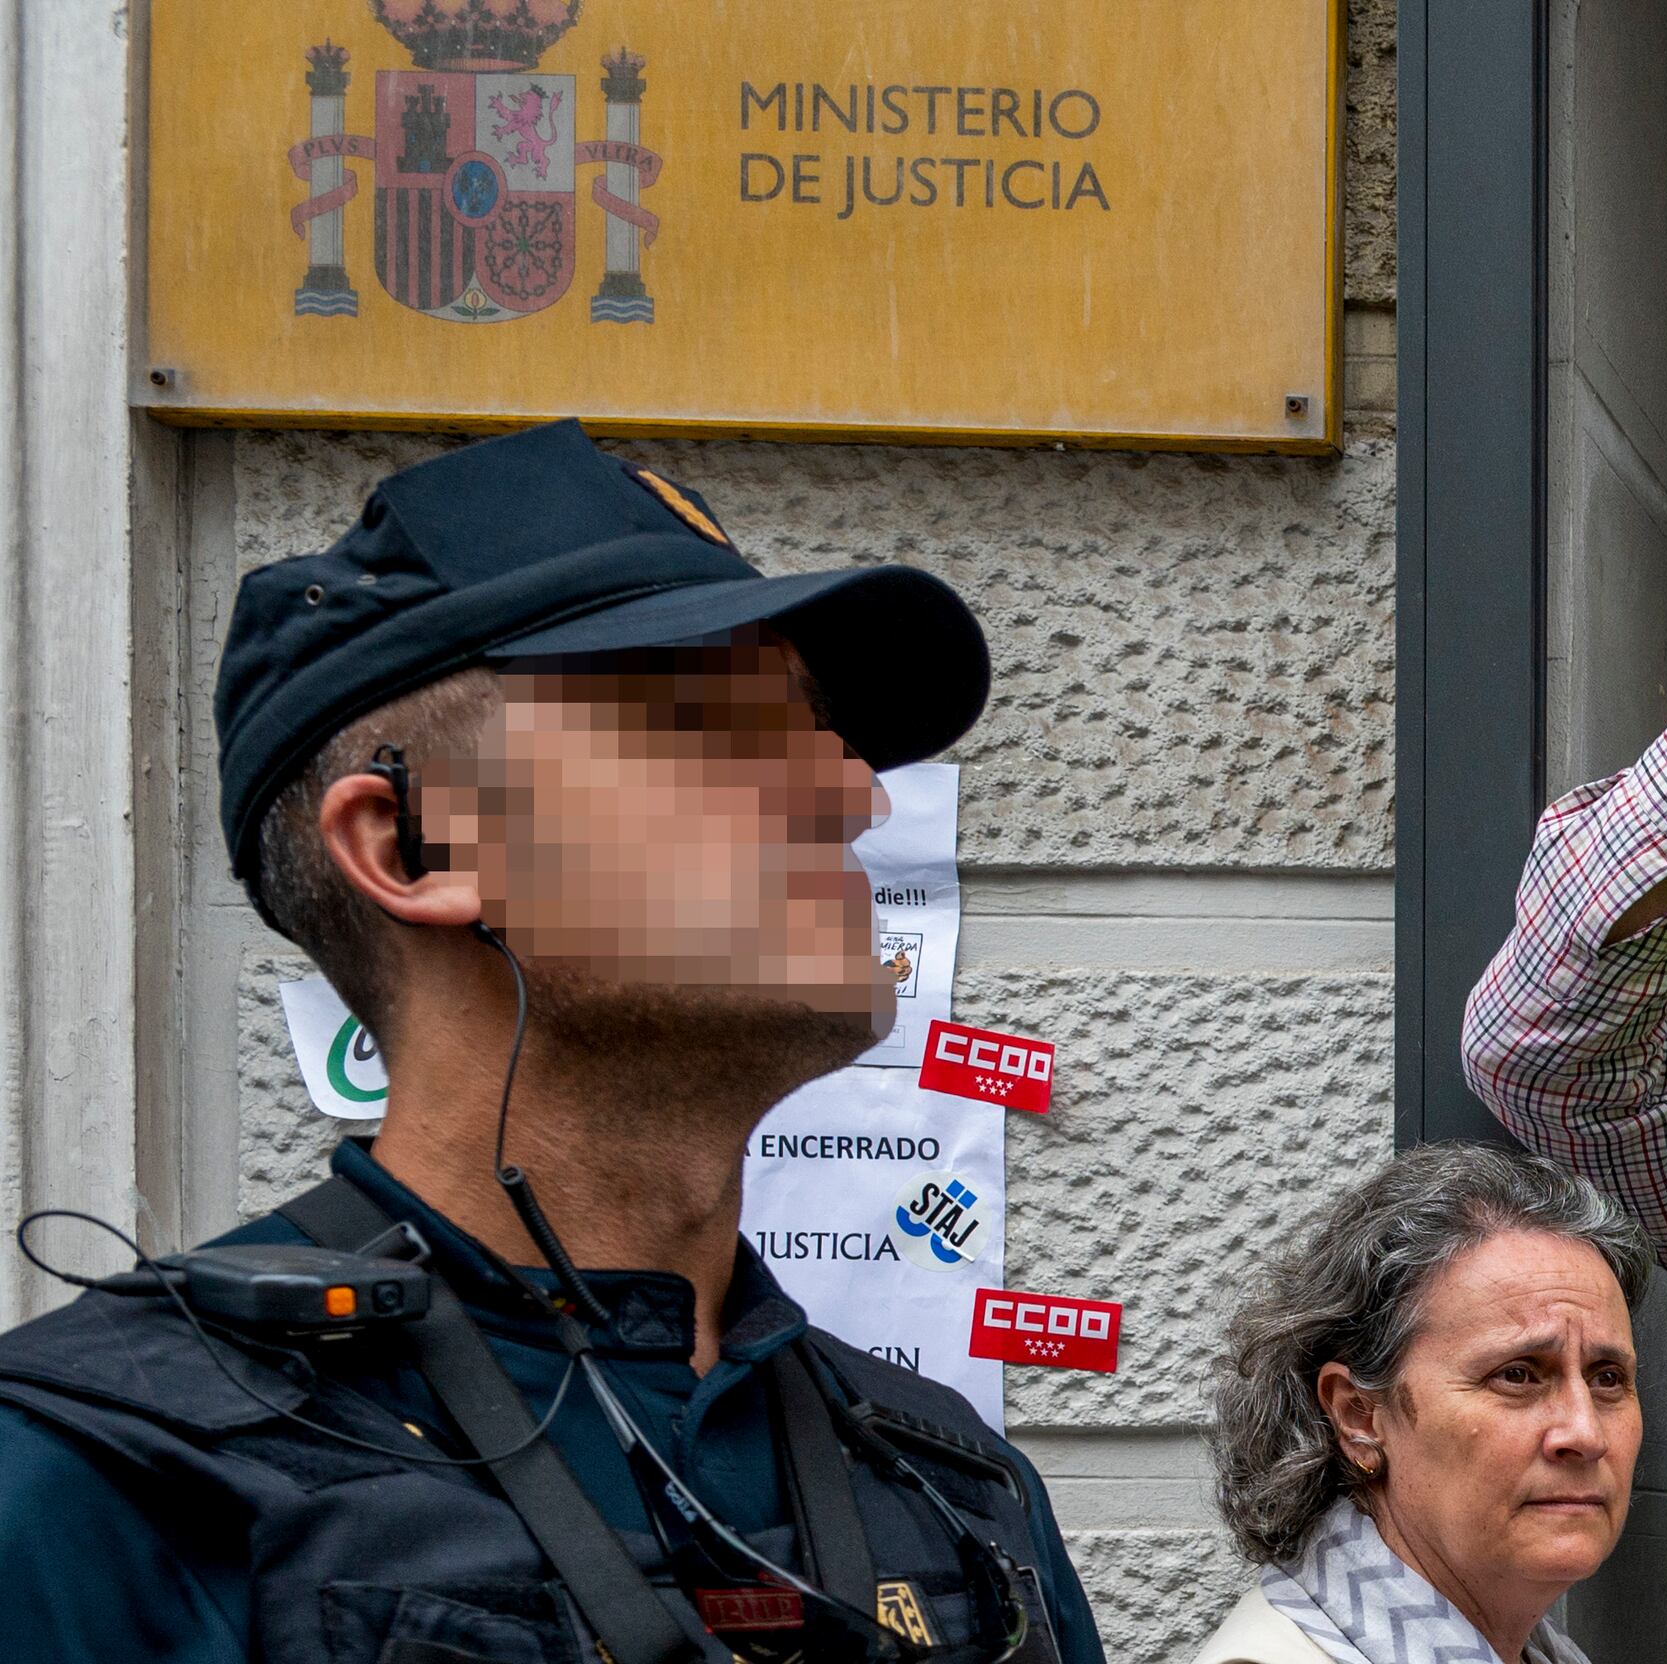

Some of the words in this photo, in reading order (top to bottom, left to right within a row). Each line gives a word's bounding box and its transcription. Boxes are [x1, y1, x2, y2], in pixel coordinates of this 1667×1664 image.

[741, 81, 1101, 139] MINISTERIO
[303, 136, 358, 158] PLVS
[741, 153, 821, 204] DE
[837, 156, 1111, 220] JUSTICIA
[875, 887, 927, 906] die!!!
[934, 1031, 1052, 1082] CCOO
[760, 1134, 940, 1161] ENCERRADO
[910, 1183, 980, 1248] STAJ
[756, 1231, 901, 1262] JUSTICIA
[983, 1298, 1111, 1340] CCOO
